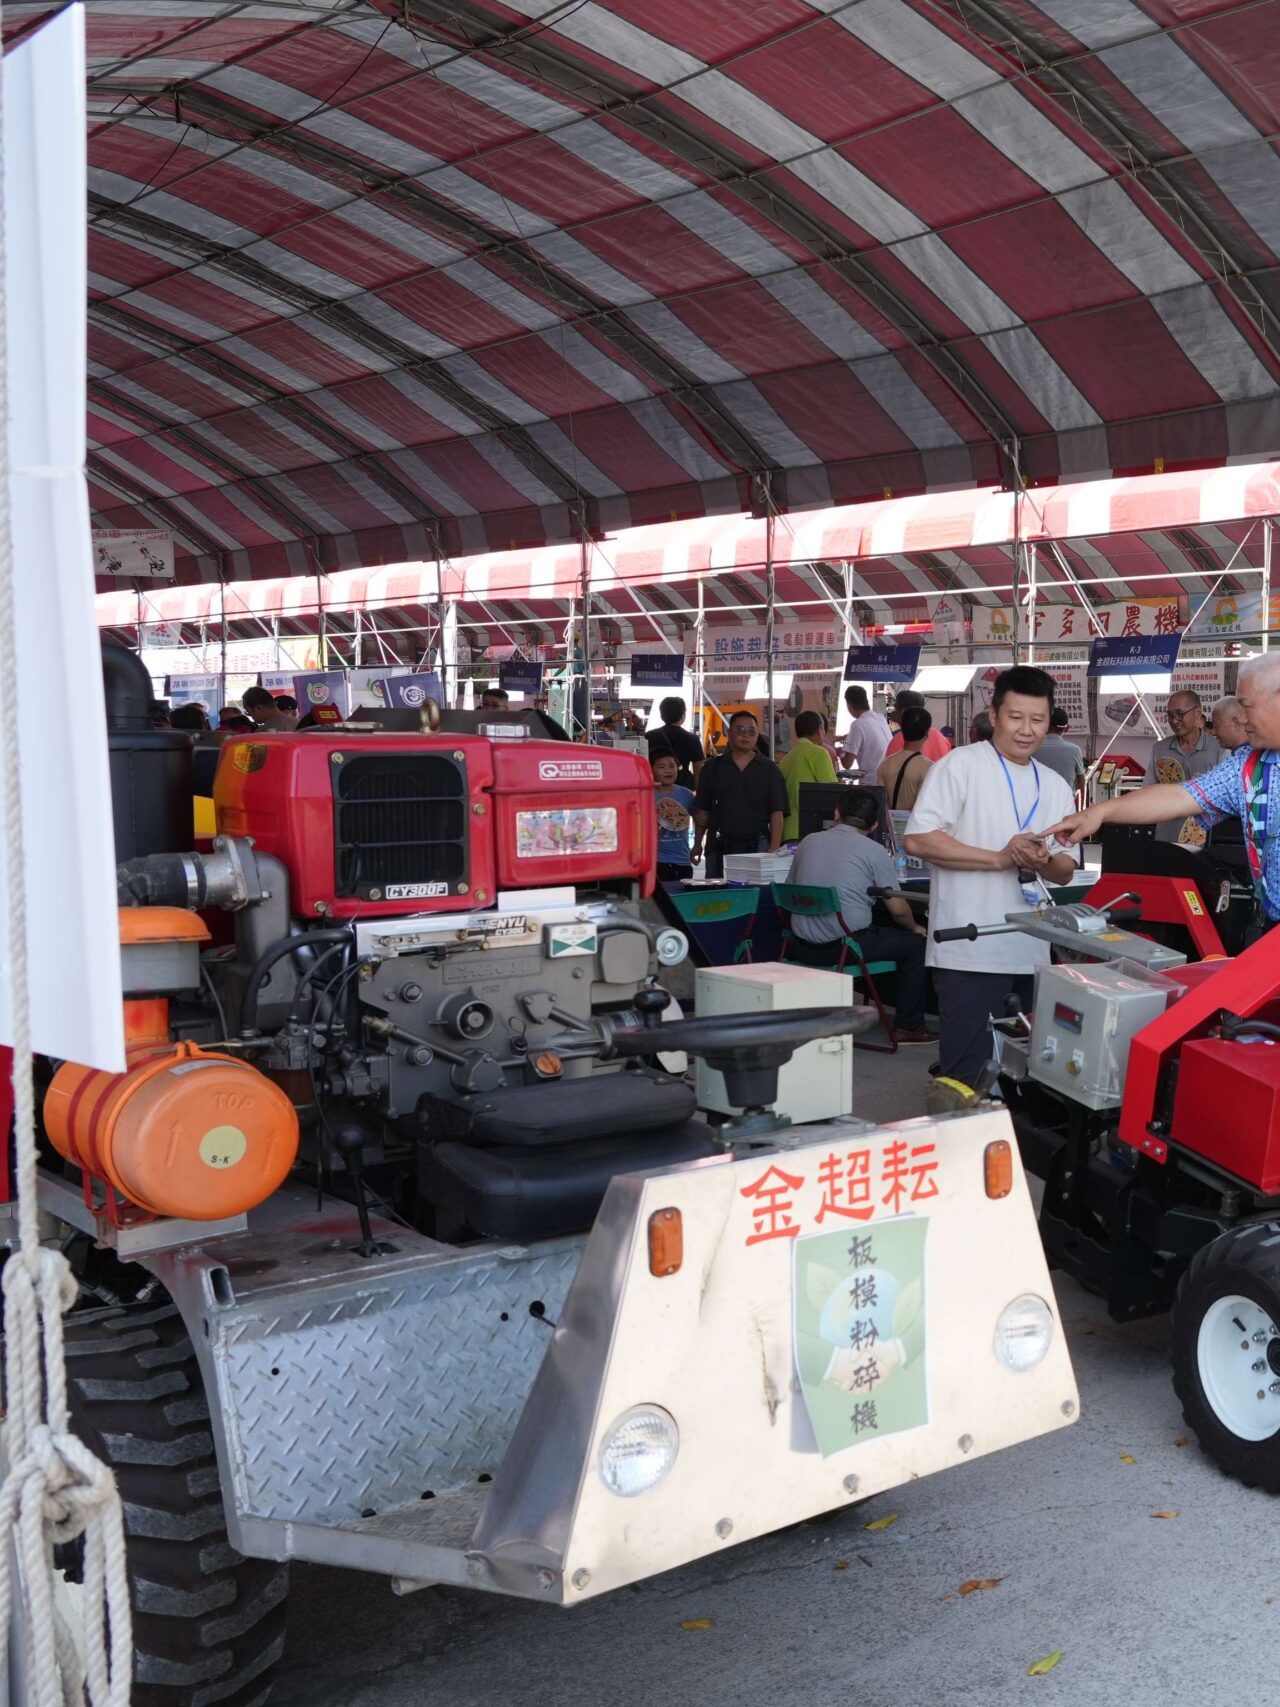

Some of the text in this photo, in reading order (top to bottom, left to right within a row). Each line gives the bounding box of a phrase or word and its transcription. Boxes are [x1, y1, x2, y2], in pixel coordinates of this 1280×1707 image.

[1130, 645, 1142, 654] K-3
[877, 654, 888, 662] K-4
[1095, 654, 1171, 667] 金超耘科技股份有限公司
[388, 884, 446, 898] CY300F
[495, 927, 524, 936] CY300
[210, 1154, 230, 1165] S-K
[739, 1139, 942, 1248] 金超耘
[847, 1234, 882, 1435] 板模粉碎機
